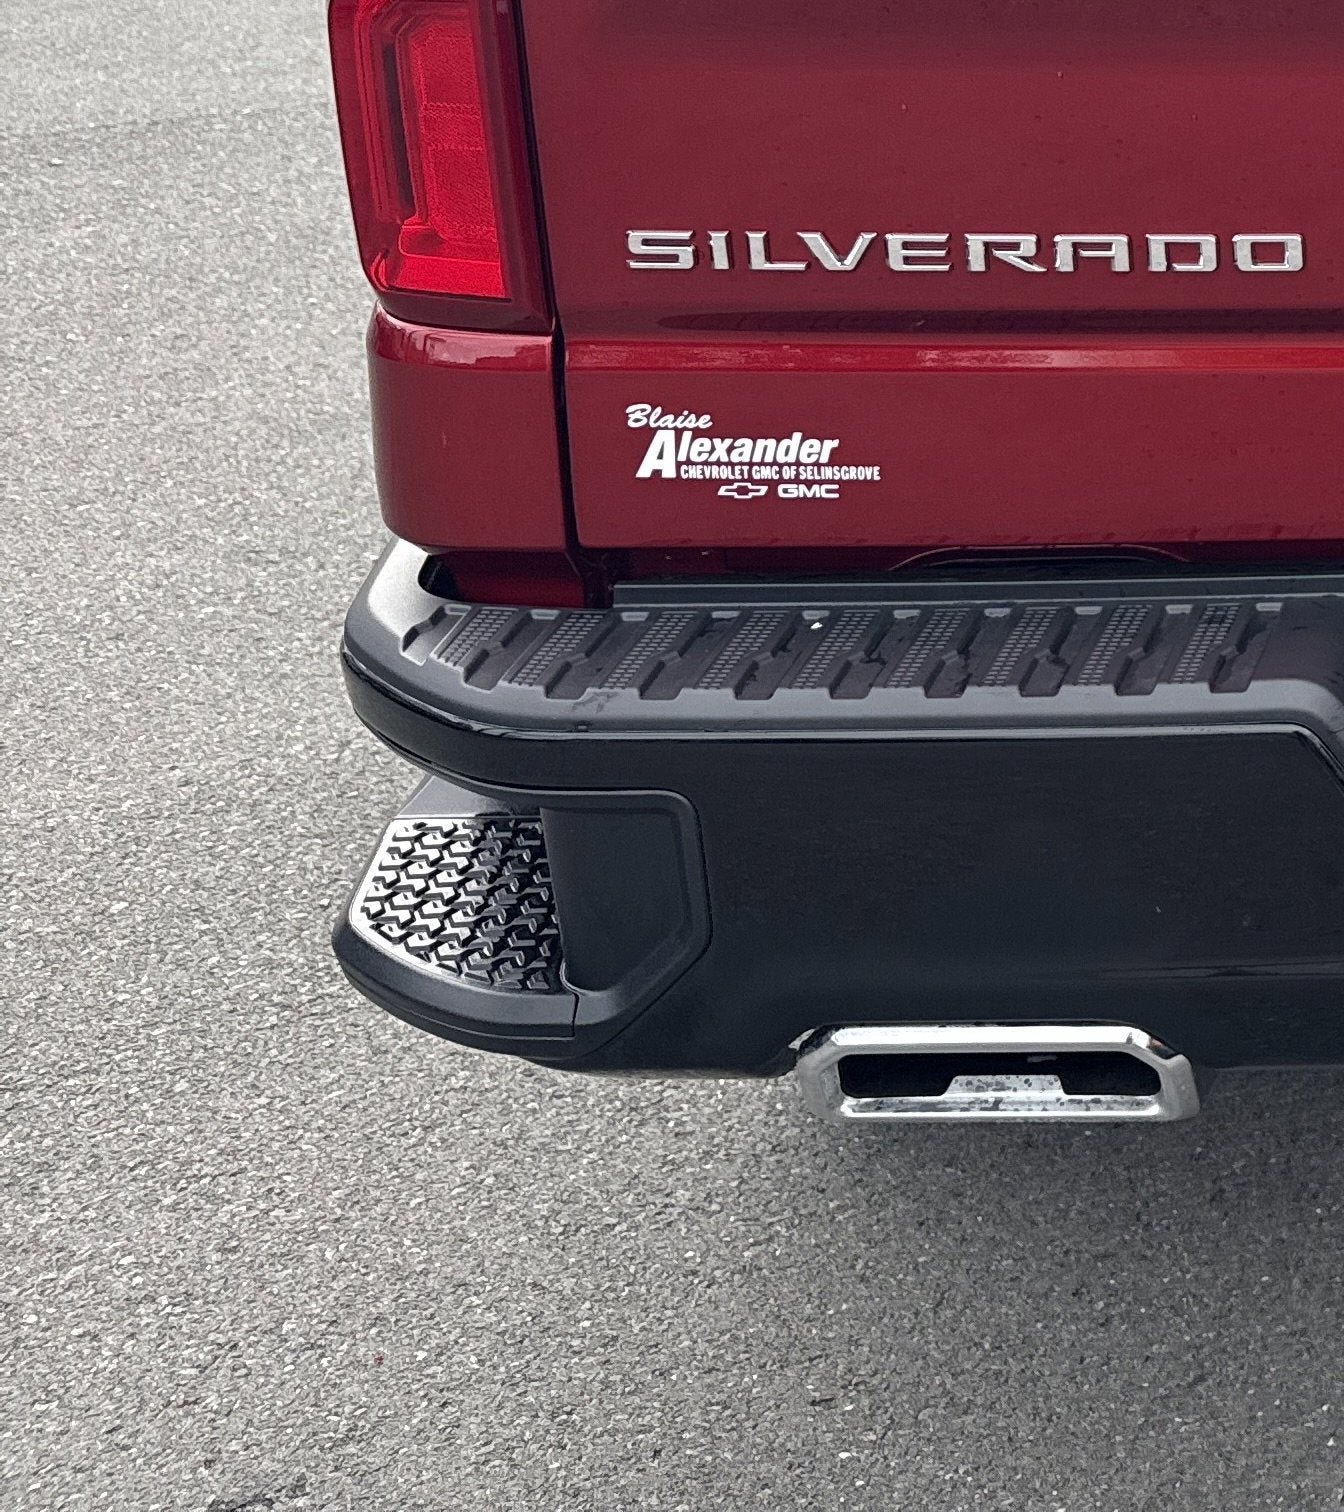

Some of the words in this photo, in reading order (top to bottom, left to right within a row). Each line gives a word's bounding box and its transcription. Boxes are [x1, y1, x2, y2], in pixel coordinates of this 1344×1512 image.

[626, 229, 1305, 273] SILVERADO
[625, 403, 713, 430] Blaise
[635, 429, 840, 479] Alexander
[680, 464, 749, 480] CHEVROLET
[752, 465, 780, 480] GMC
[782, 465, 797, 480] OF
[799, 464, 881, 480] SELINSGROVE
[777, 483, 840, 499] GMC
